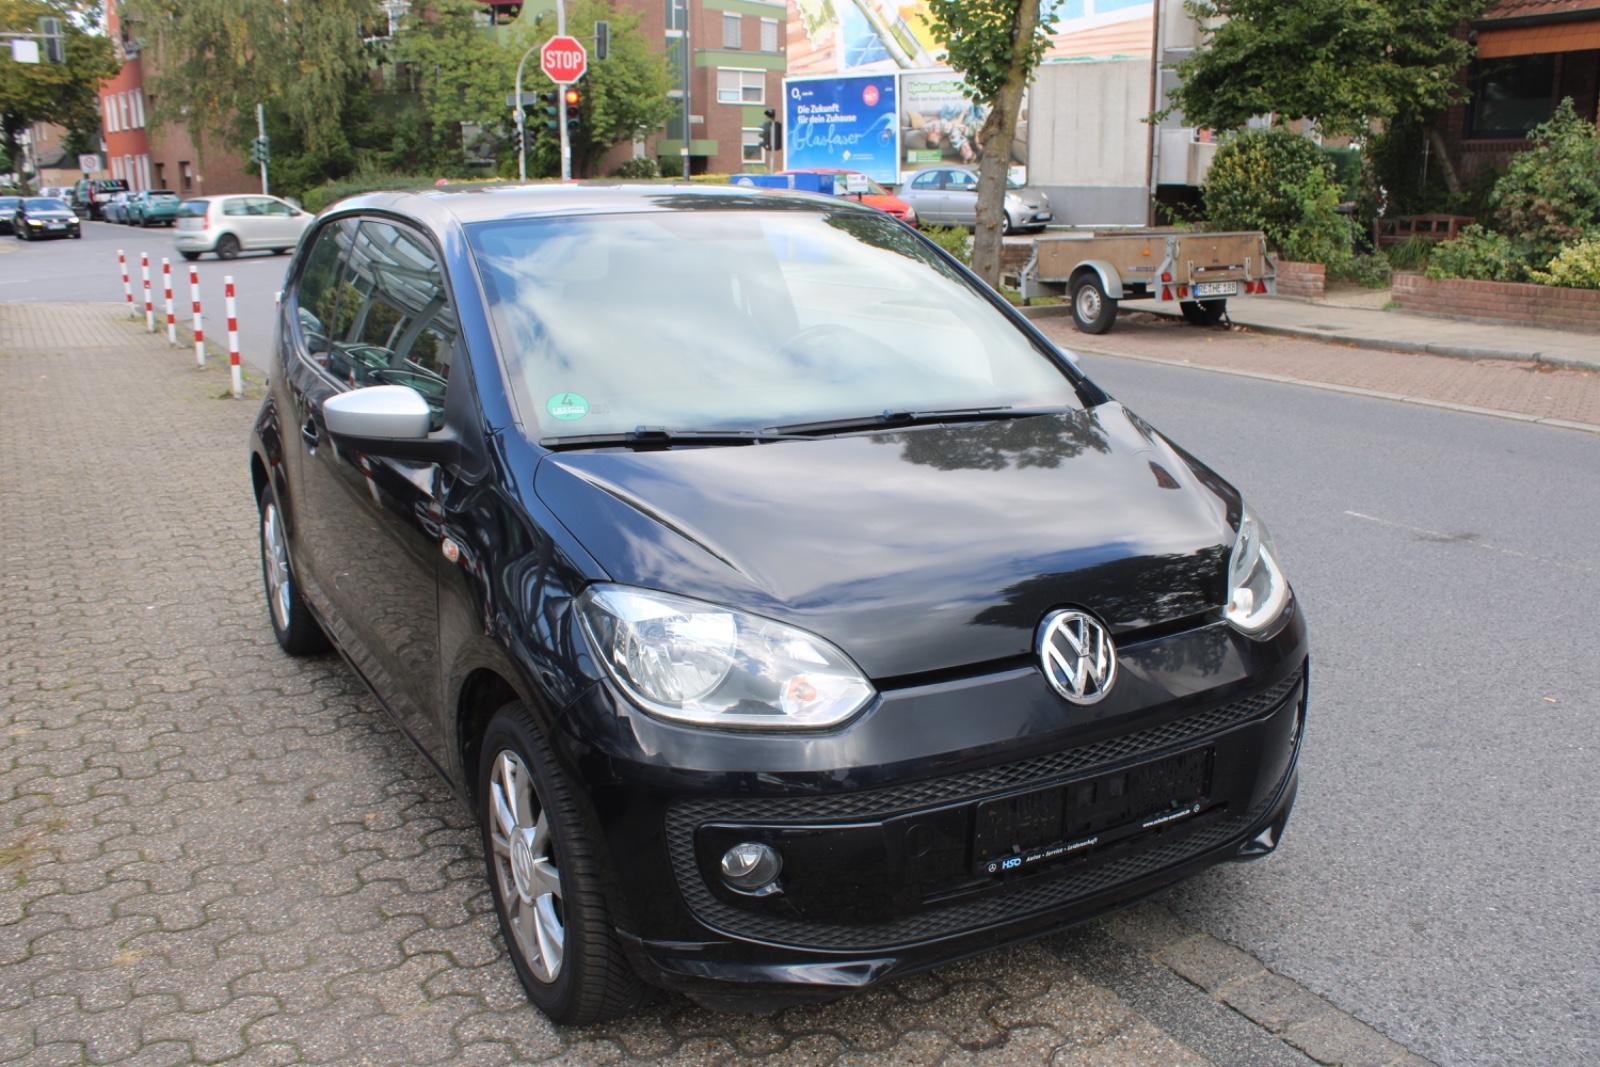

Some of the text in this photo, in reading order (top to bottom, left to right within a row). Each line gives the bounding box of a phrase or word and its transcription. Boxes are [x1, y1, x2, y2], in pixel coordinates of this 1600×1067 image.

[545, 50, 582, 69] STOP
[797, 103, 840, 114] Die Zukunft
[797, 114, 857, 124] für dein Zuhause
[789, 122, 861, 154] Glasfaser
[560, 392, 574, 406] 4
[1045, 848, 1063, 857] Service
